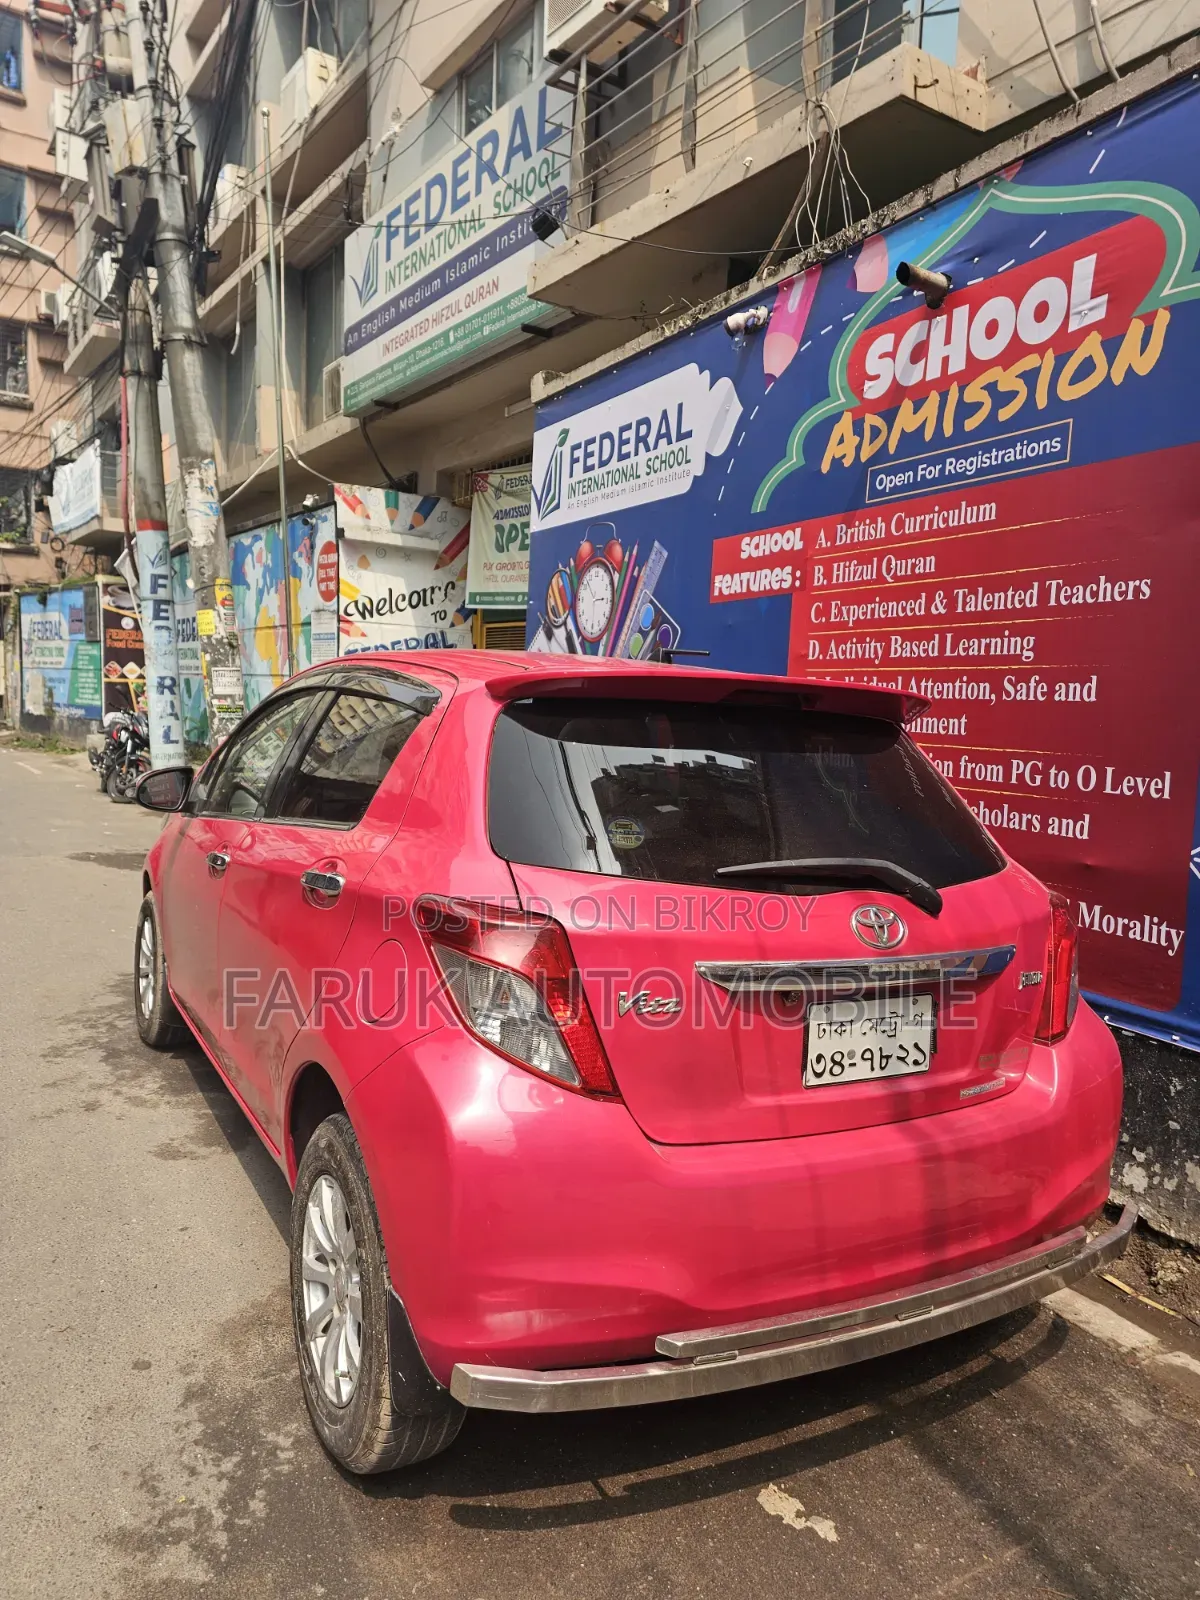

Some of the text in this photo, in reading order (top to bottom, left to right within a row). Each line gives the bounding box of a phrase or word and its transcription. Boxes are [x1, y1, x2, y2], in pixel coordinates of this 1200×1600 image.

[385, 86, 563, 263] FEDERAL
[384, 152, 561, 294] INTERNATIONAL SCHOOL
[346, 332, 359, 347] An
[361, 305, 396, 338] English
[399, 278, 441, 314] Medium
[445, 247, 491, 284] Islamic
[383, 317, 430, 357] INTEGRATED
[431, 298, 463, 329] HIFZUL
[464, 276, 499, 310] QURAN
[862, 252, 1109, 400] SCHOOL
[820, 307, 1171, 474] ADMISSION
[568, 401, 693, 479] FEDERAL
[875, 433, 1062, 493] Open For Registrations
[567, 444, 692, 500] INTERNATIONAL SCHOOL
[601, 487, 627, 501] Medium
[628, 479, 655, 494] Islamic
[657, 469, 691, 485] Institute
[492, 503, 531, 520] ADMISSIO
[815, 500, 997, 550] A. British Curriculum
[494, 521, 530, 554] OPE
[741, 527, 804, 560] SCHOOL
[812, 554, 937, 587] B. Hifzul Quran
[810, 575, 1152, 627] C. Experienced & Talented Teachers
[176, 616, 199, 643] FEDE
[807, 630, 1036, 664] D. Activity Based Learning
[908, 675, 997, 705] Attention,
[1002, 674, 1048, 702] Safe
[1054, 675, 1098, 702] and
[959, 755, 1004, 783] from
[1010, 759, 1043, 787] PG
[1049, 766, 1070, 790] to
[1076, 764, 1097, 793] O
[1103, 766, 1172, 799] Level
[966, 800, 1090, 840] cholars and
[1077, 900, 1185, 957] Morality
[617, 990, 683, 1019] Vitz
[816, 1018, 855, 1041] ঢাকা
